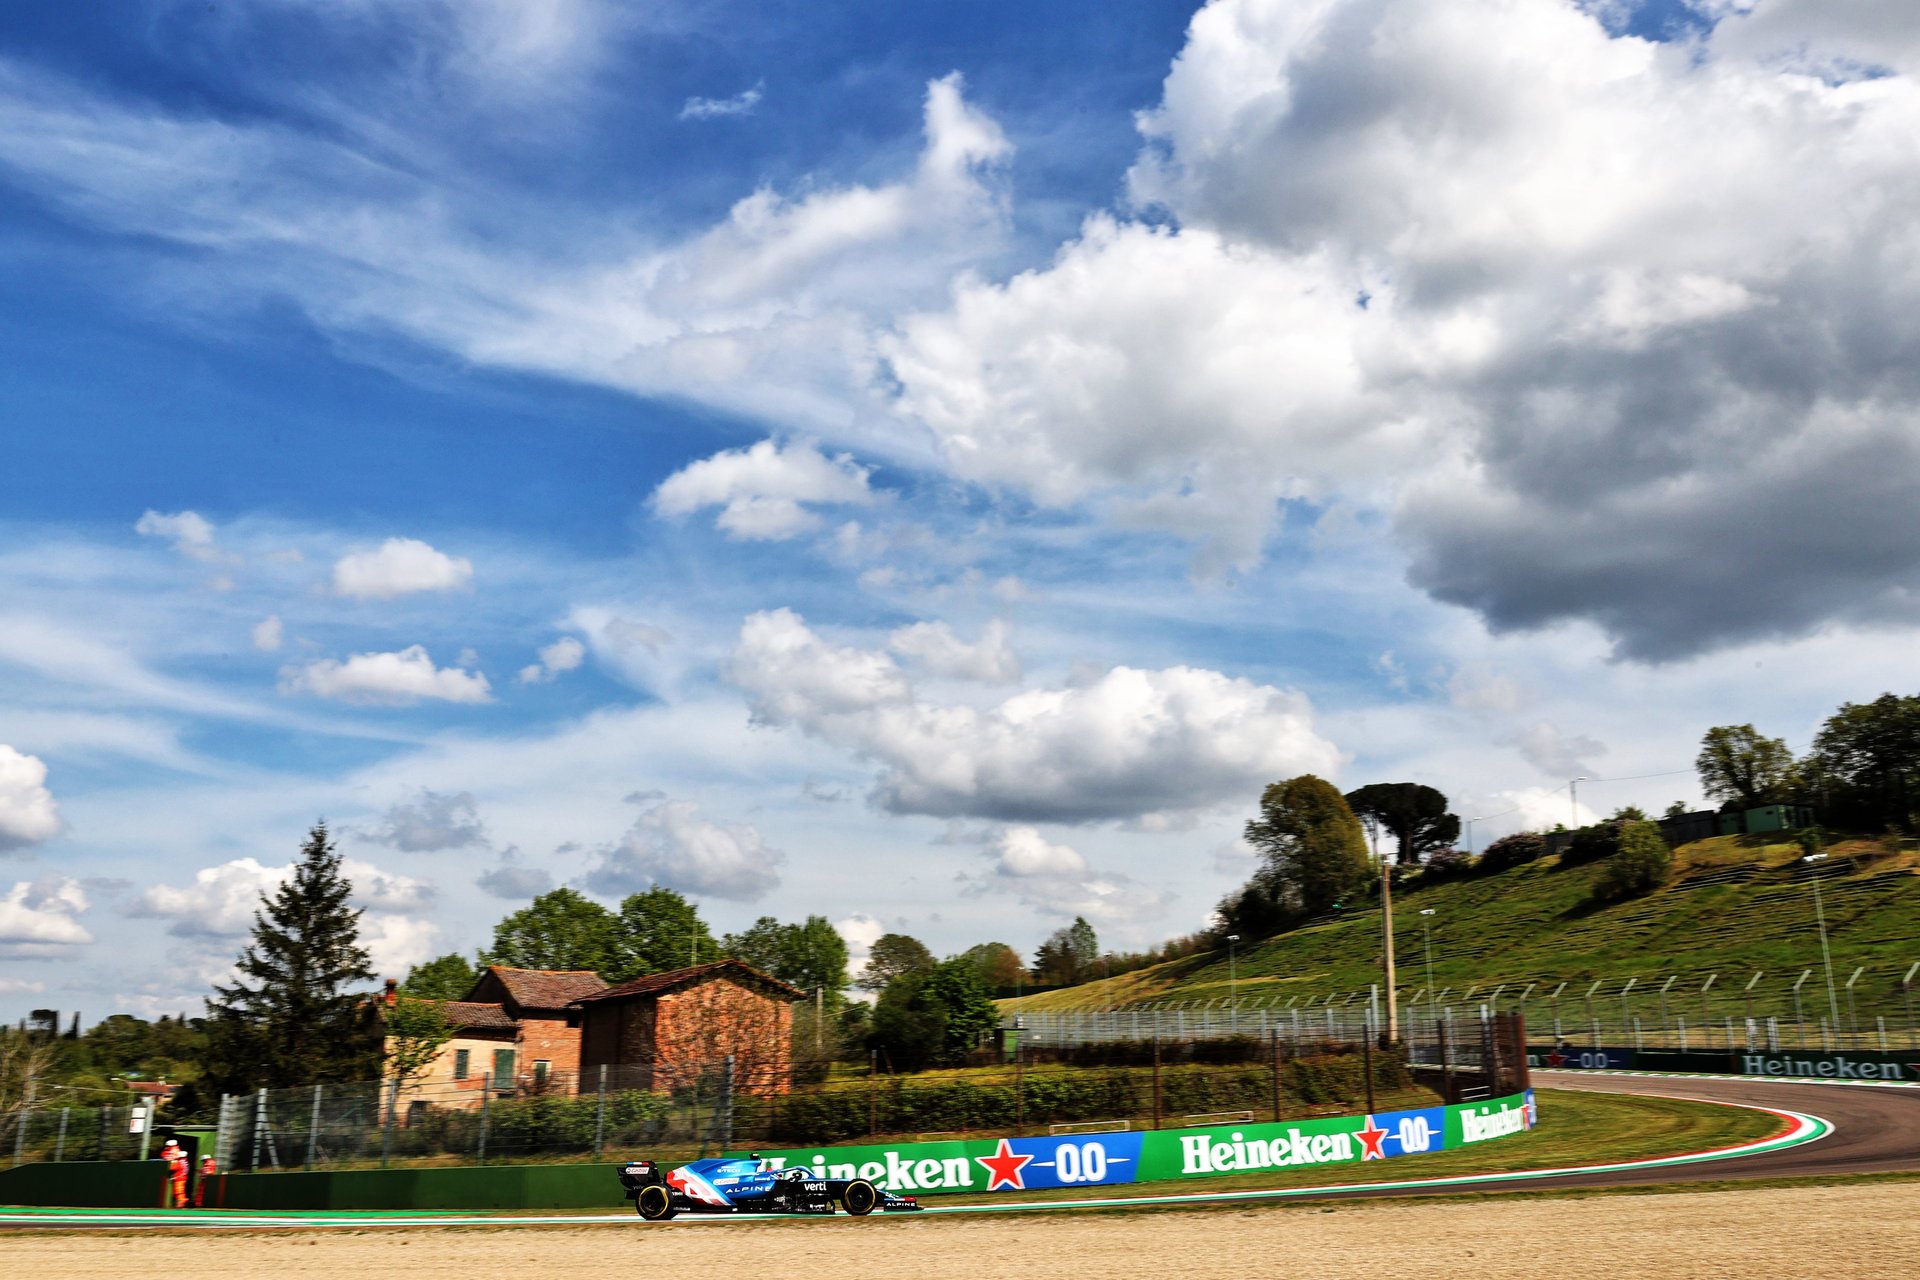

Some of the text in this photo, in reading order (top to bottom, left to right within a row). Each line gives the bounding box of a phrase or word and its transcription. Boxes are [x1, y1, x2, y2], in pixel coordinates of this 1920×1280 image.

[1742, 1055, 1903, 1081] Heineken
[1398, 1116, 1430, 1153] 0.0
[1459, 1103, 1524, 1144] Heineken
[1055, 1141, 1107, 1185] 0.0
[1180, 1128, 1353, 1174] Heineken
[725, 1186, 772, 1194] ALPINE
[804, 1181, 827, 1191] verti
